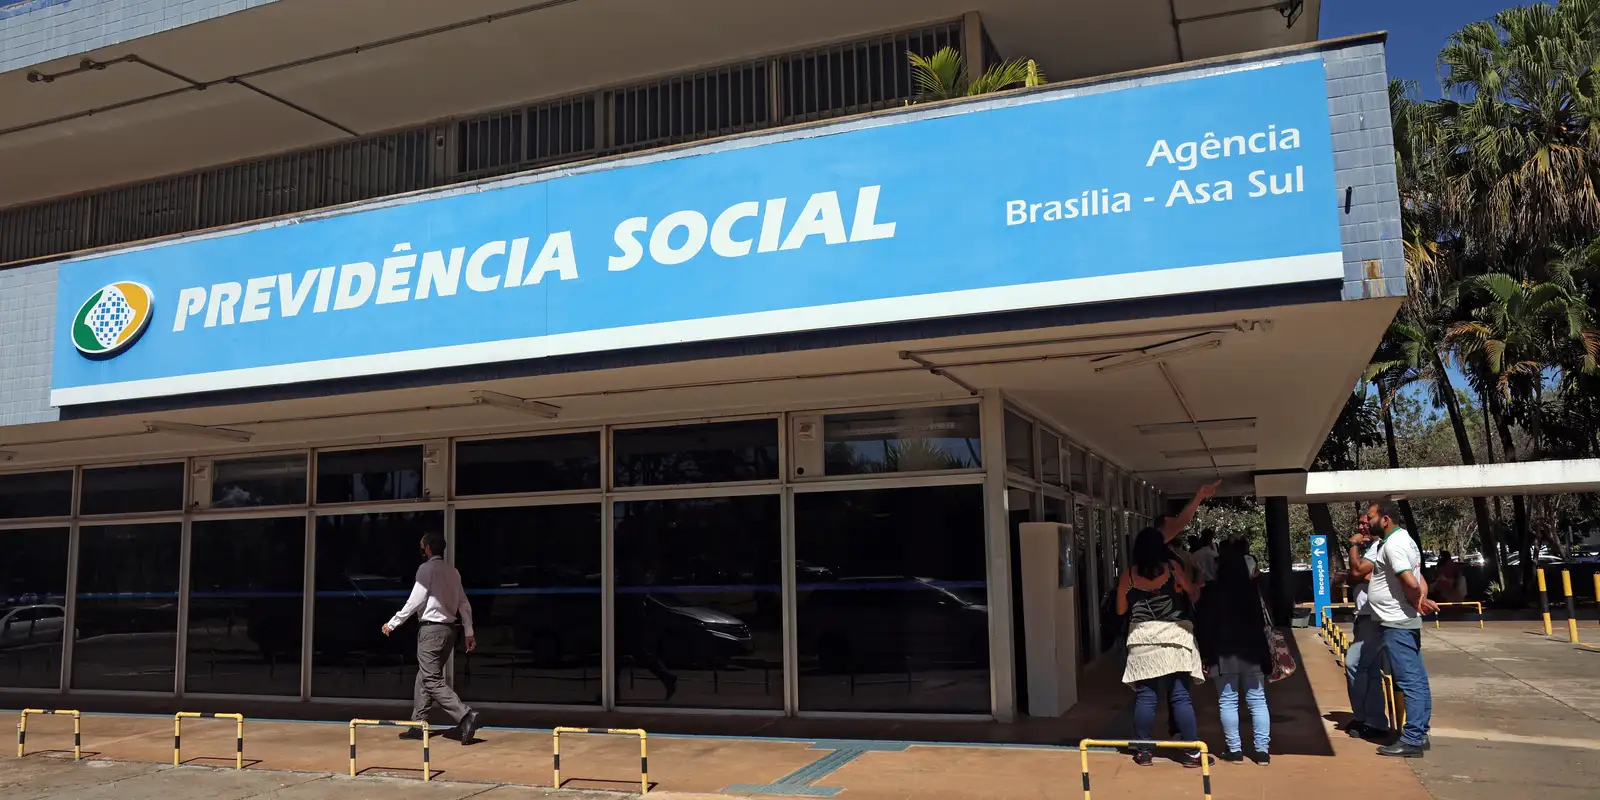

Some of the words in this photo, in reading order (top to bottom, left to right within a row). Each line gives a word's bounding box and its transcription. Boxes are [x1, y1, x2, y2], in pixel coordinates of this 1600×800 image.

[1146, 124, 1301, 171] Agência
[1006, 189, 1131, 226] Brasília
[1165, 179, 1233, 207] Asa
[1248, 165, 1305, 198] Sul
[173, 231, 578, 332] PREVIDÊNCIA
[608, 185, 897, 272] SOCIAL
[1317, 560, 1325, 595] Recepção
